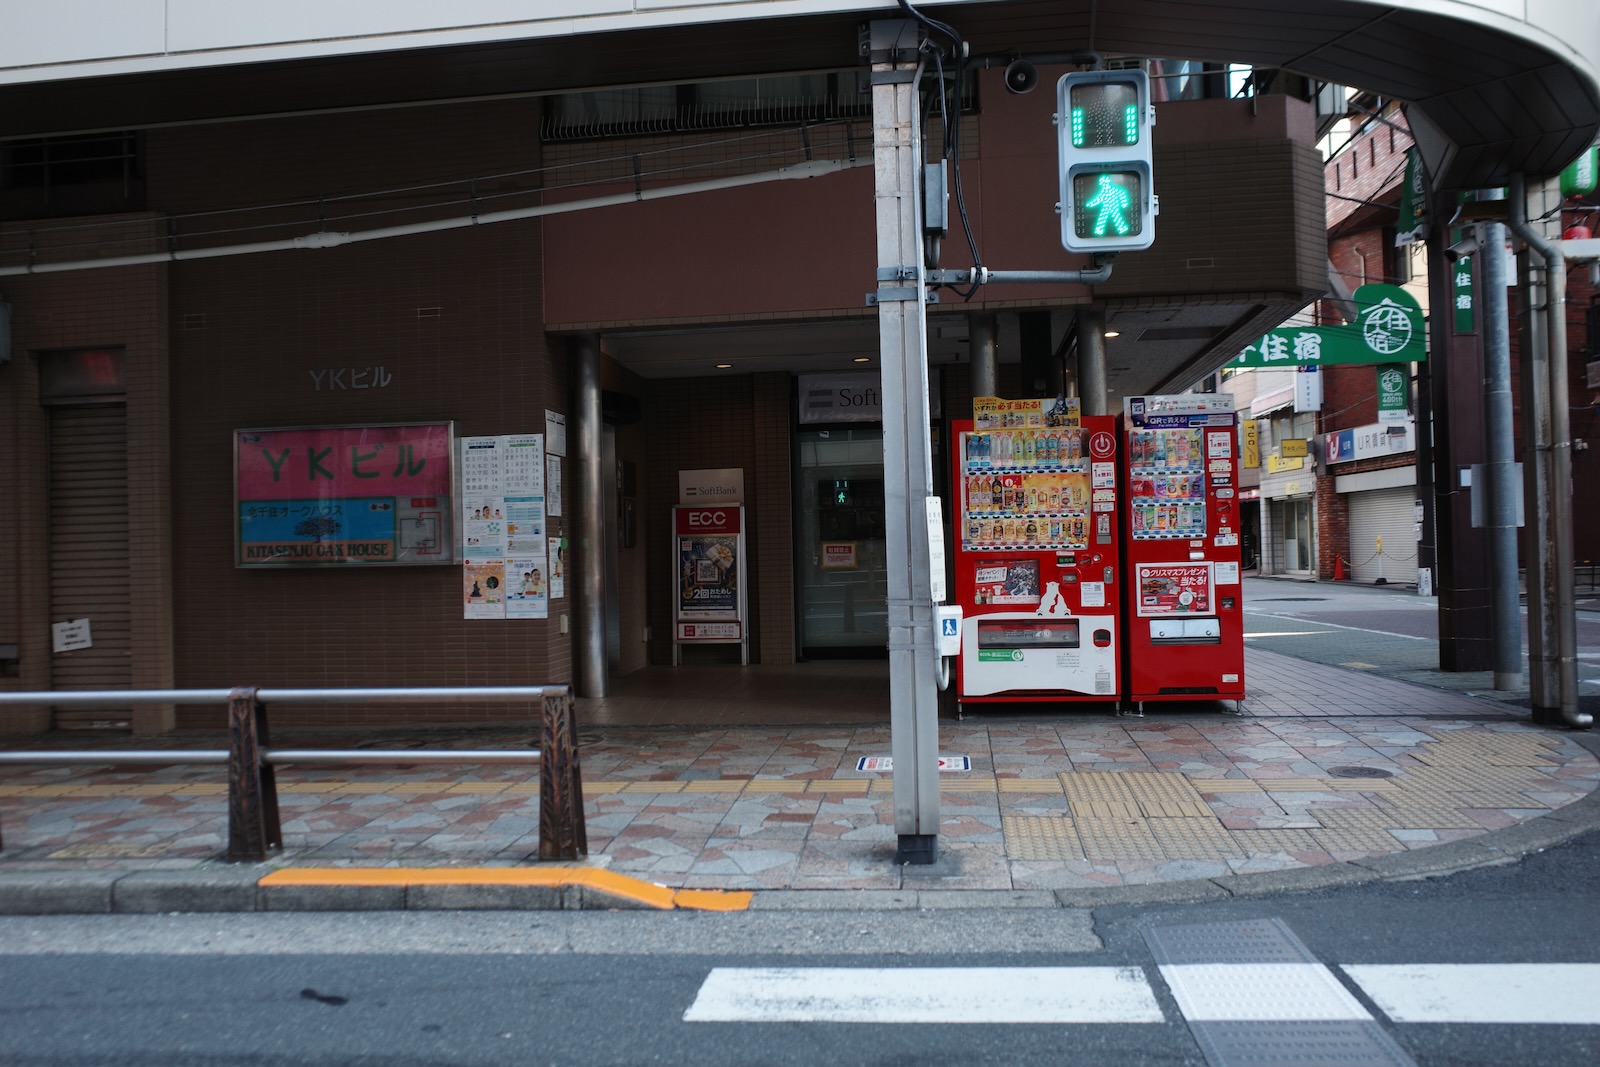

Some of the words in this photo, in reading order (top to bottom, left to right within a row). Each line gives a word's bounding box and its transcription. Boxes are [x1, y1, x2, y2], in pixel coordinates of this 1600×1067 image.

[309, 366, 392, 391] YKビル
[840, 388, 882, 407] Soft
[263, 443, 427, 482] YKビル
[699, 486, 737, 496] SoftBank
[247, 504, 344, 518] 北千住オークハウス
[689, 511, 727, 526] ECC
[247, 543, 313, 558] KITASENJU
[316, 543, 345, 557] OAK
[347, 542, 389, 556] HOUSE
[1150, 568, 1207, 577] クリスマスプレゼント
[1180, 576, 1207, 586] 当たる!
[693, 588, 710, 599] 2回
